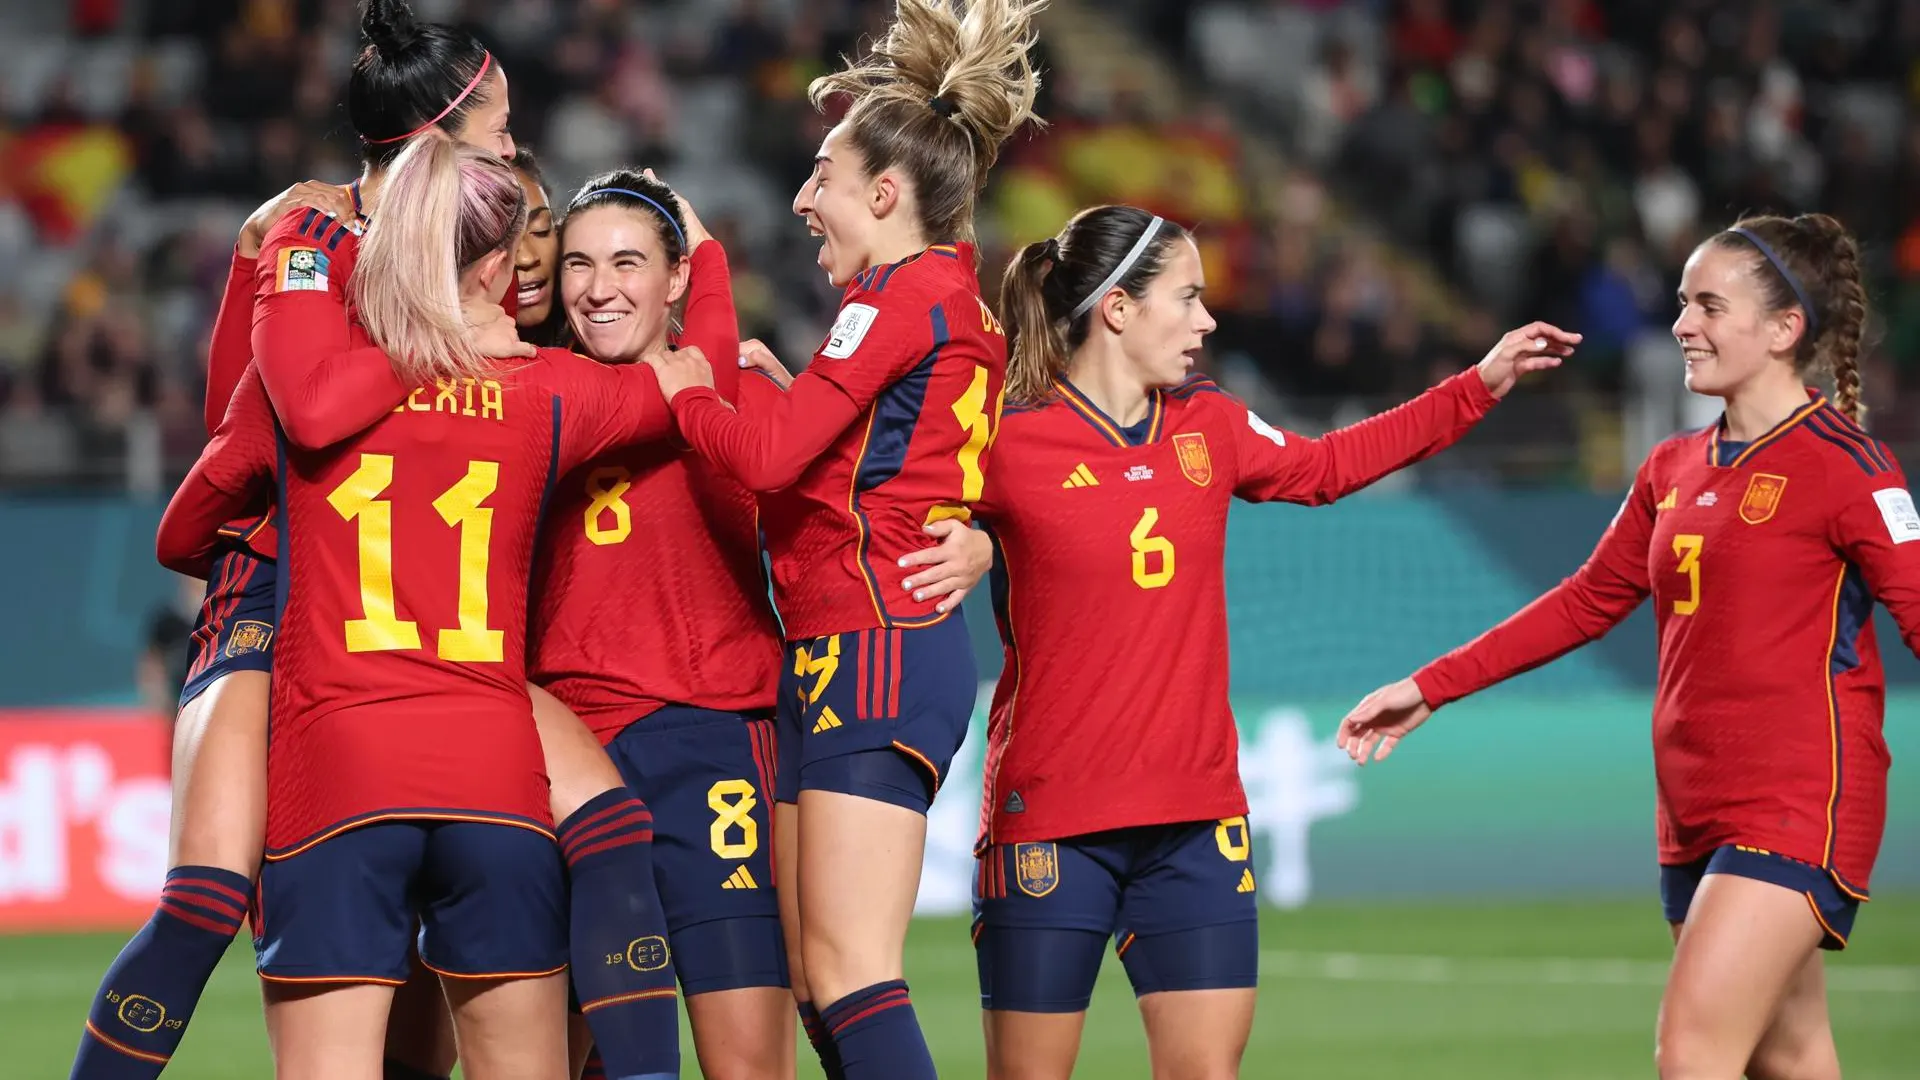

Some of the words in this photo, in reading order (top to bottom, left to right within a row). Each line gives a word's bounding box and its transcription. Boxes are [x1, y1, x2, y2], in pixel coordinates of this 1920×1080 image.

[584, 466, 632, 546] 8
[326, 453, 504, 663] 11
[1130, 507, 1175, 589] 6
[1672, 534, 1704, 615] 3
[707, 779, 758, 859] 8
[606, 952, 623, 965] 19
